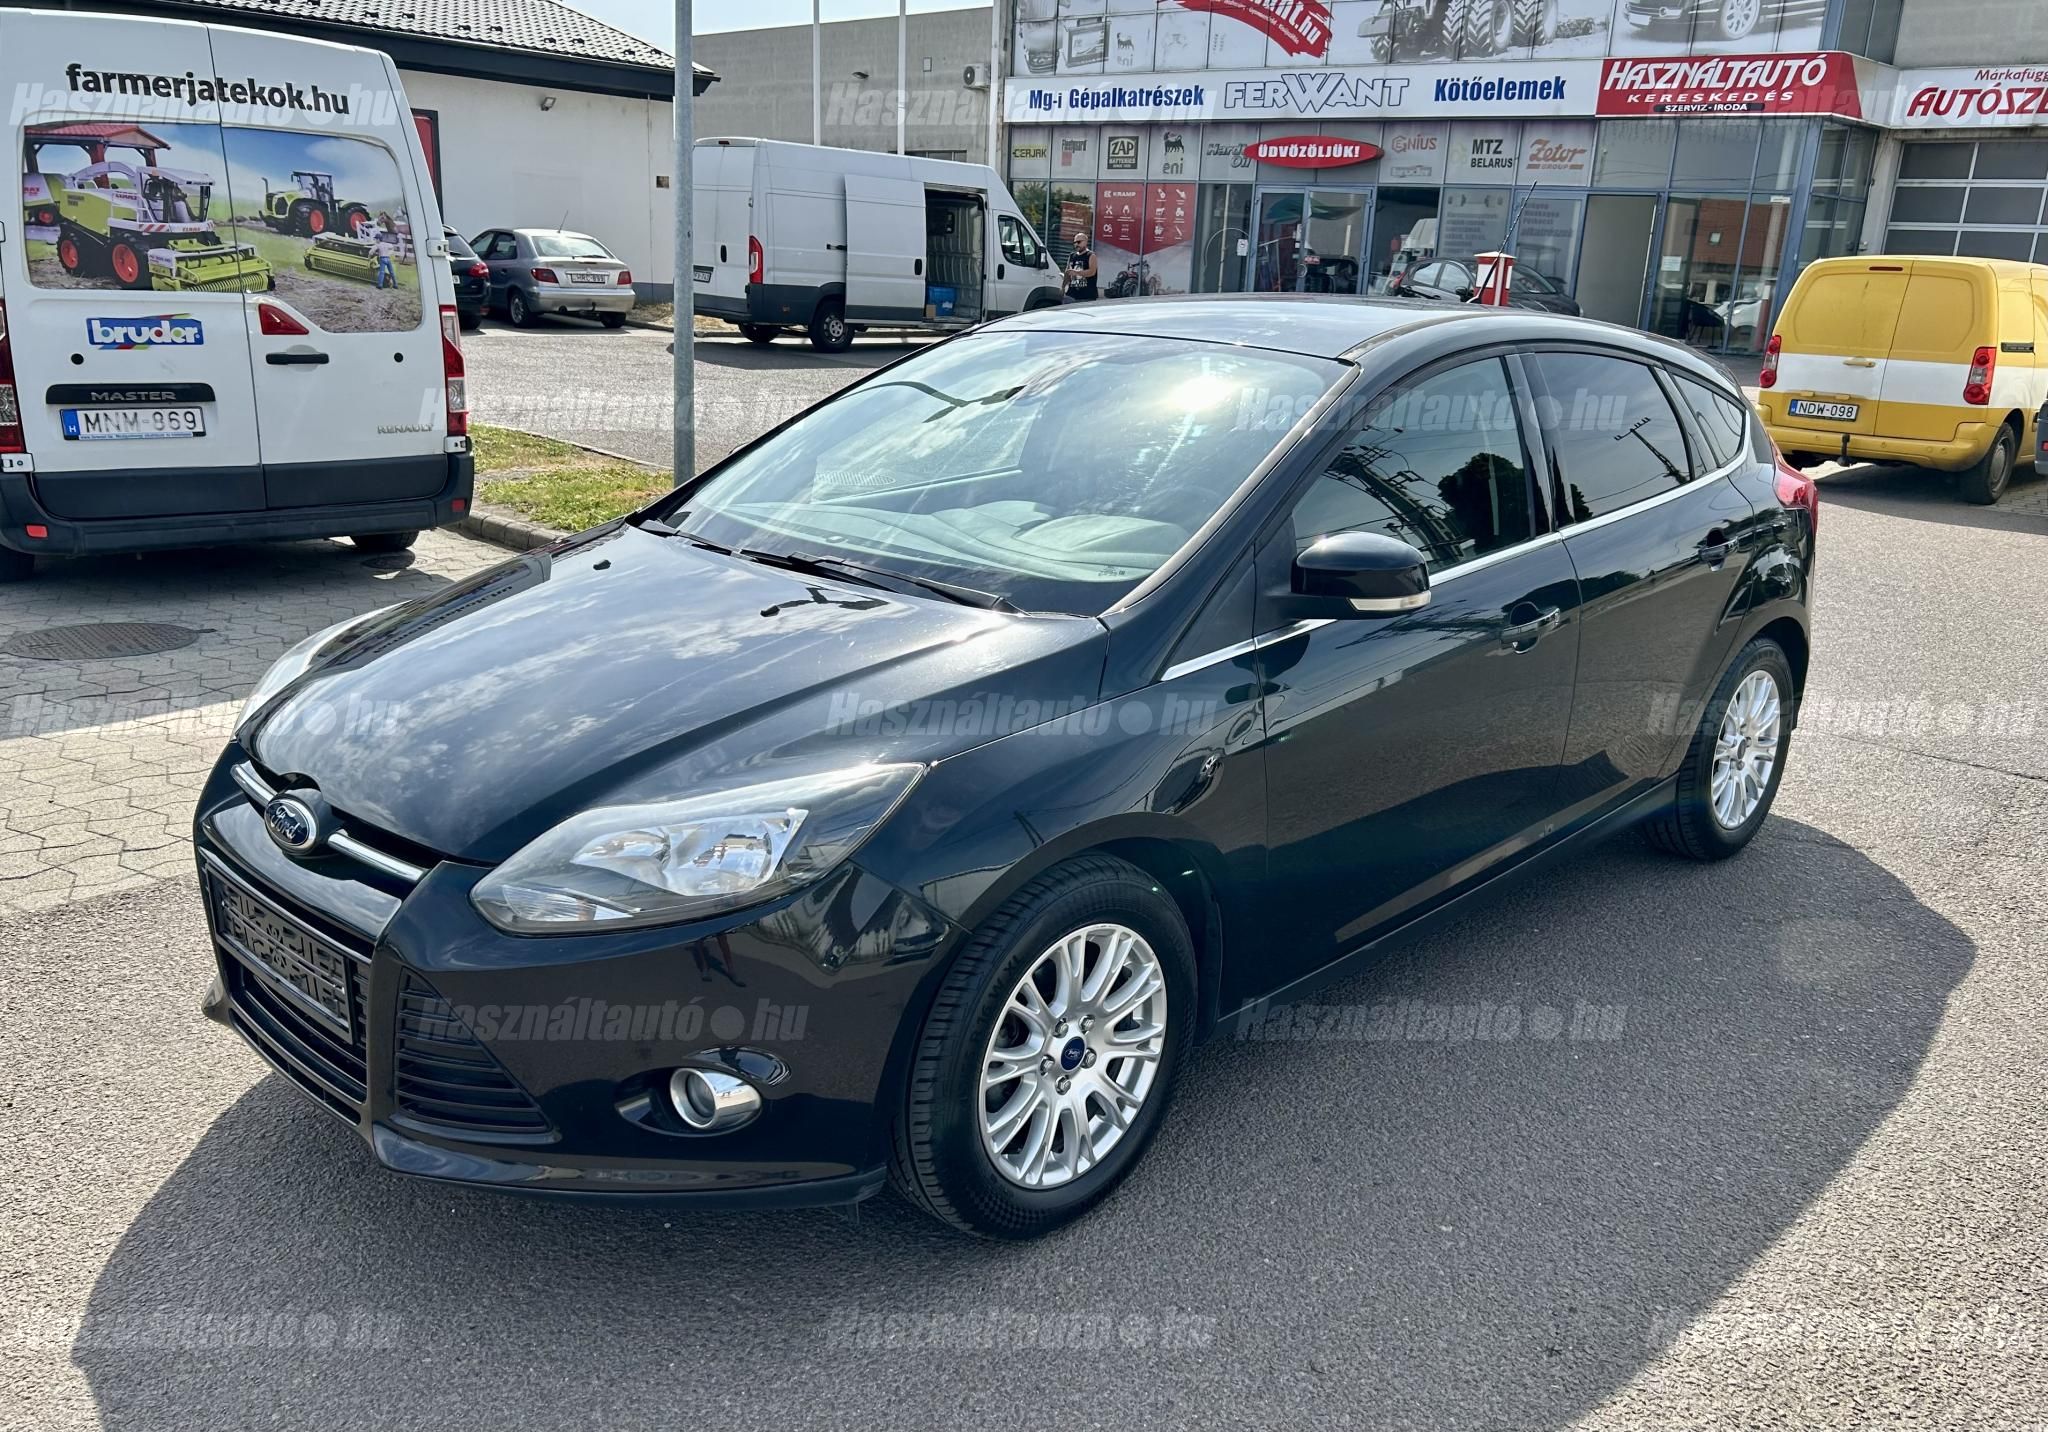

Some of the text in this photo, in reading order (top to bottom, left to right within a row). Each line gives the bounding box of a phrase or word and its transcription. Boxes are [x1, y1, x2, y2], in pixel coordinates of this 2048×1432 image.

[1604, 54, 1827, 90] HASZNÁLTAUTÓ
[66, 63, 349, 115] farmerjatekok.hu
[1069, 85, 1205, 109] Gépalkatrészek
[1224, 73, 1410, 113] FERWANT
[1434, 76, 1566, 102] Kötőelemek
[1626, 91, 1794, 103] KERESKEDÉS
[1110, 140, 1135, 156] ZAP
[1258, 144, 1360, 158] ÜDVÖZÖLJÜK!
[1472, 139, 1504, 154] MTZ
[1529, 138, 1588, 163] Zetor
[1162, 158, 1184, 175] eni
[1471, 157, 1513, 169] BELARUS
[93, 318, 199, 345] bruder
[90, 391, 176, 401] MASTER
[1798, 403, 1854, 417] NDW-098
[84, 409, 197, 433] MNM-869
[377, 423, 433, 434] RENAULT
[270, 805, 297, 839] Ford
